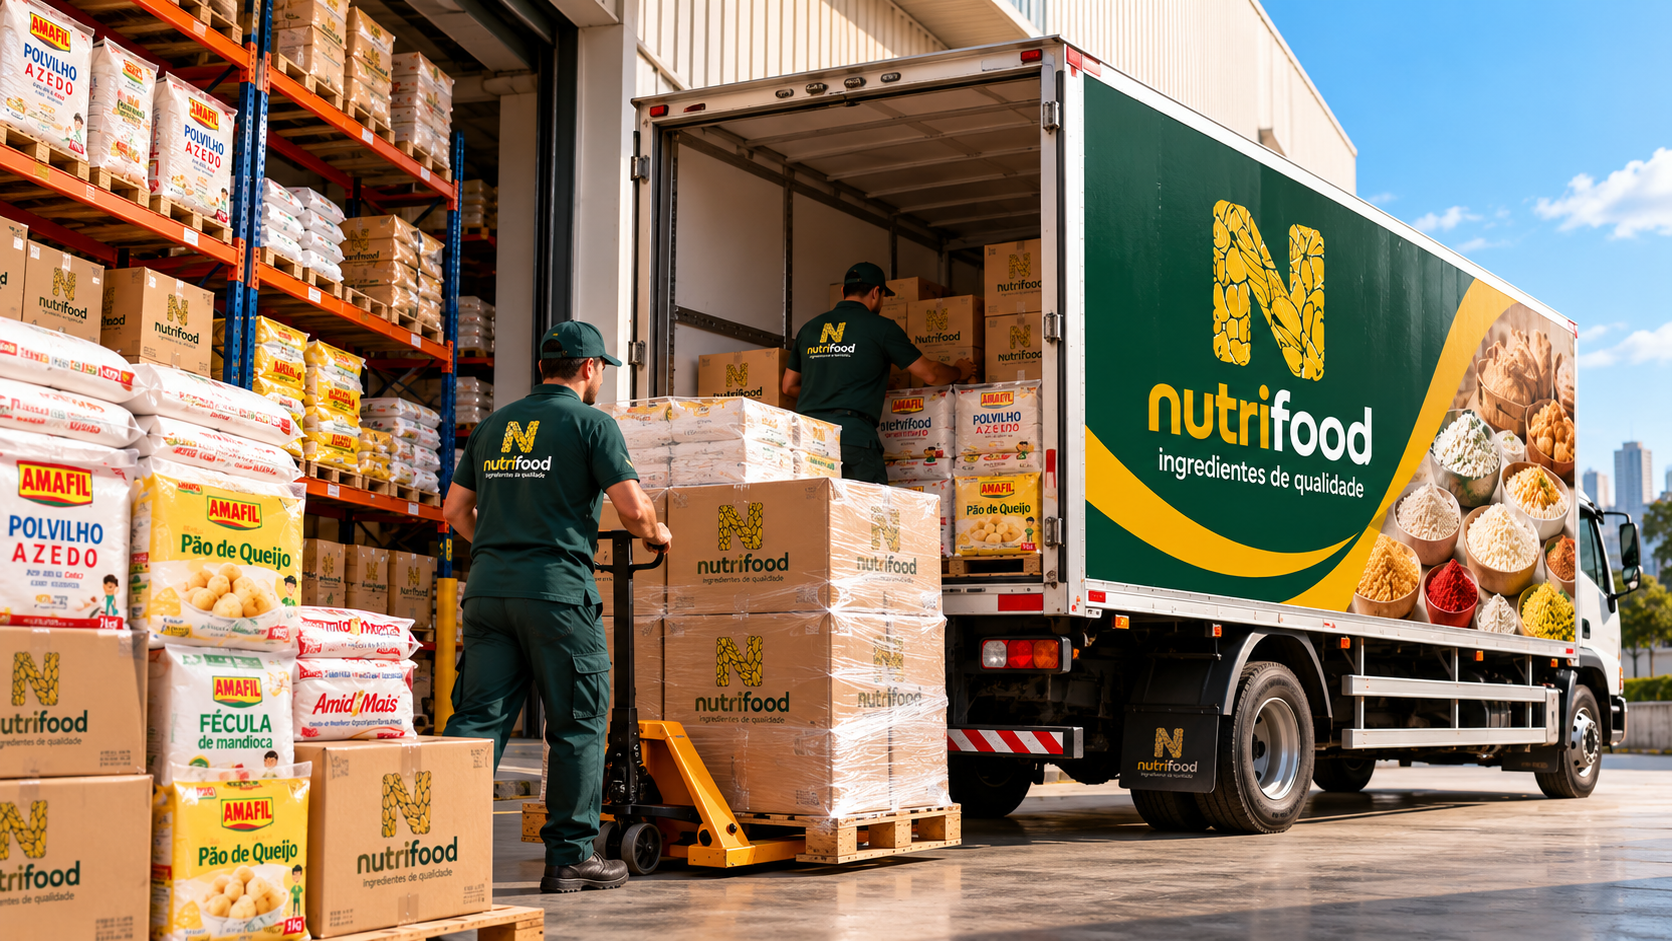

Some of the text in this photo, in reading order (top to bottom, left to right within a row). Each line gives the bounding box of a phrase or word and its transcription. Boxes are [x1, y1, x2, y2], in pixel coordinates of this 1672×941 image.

[32, 15, 69, 47] AMAFIL
[24, 42, 77, 81] POLVILHO
[25, 63, 73, 95] AZEDO
[191, 101, 218, 125] AMAFIL
[184, 124, 224, 155] POLVILHO
[185, 141, 221, 168] AZEDO
[52, 267, 76, 301] N
[1213, 199, 1325, 382] N
[39, 296, 88, 320] nutrifood
[167, 293, 188, 326] N
[155, 322, 199, 345] nutrifood
[820, 322, 846, 343] N
[807, 343, 856, 354] nutrifood
[973, 411, 1021, 425] POLVILHO
[1148, 382, 1373, 466] nutrifood
[501, 421, 540, 453] N
[483, 455, 552, 471] nutrifood
[1158, 447, 1364, 498] ingredientes de qualidade
[22, 467, 91, 497] AMAFIL
[209, 499, 260, 523] AMAFIL
[986, 504, 998, 514] de
[999, 502, 1031, 515] Queijo
[9, 515, 103, 544] POLVILHO
[717, 502, 763, 551] N
[11, 542, 98, 568] AZEDO
[217, 539, 236, 559] de
[240, 543, 291, 571] Queijo
[697, 552, 789, 575] nutrifood
[857, 554, 917, 575] nutrifood
[716, 636, 763, 687] N
[11, 652, 60, 706] N
[215, 679, 261, 697] AMAFIL
[359, 692, 398, 713] Mais
[695, 691, 789, 712] nutrifood
[200, 709, 272, 733] FÉCULA
[36, 738, 45, 746] de
[47, 737, 82, 747] qualidade
[198, 735, 273, 749] de mandioca
[1154, 727, 1184, 758] N
[1137, 760, 1198, 772] nutrifood
[224, 800, 272, 822] AMAFIL
[381, 770, 432, 838] N
[231, 844, 249, 863] de
[252, 839, 298, 865] Queijo
[357, 836, 458, 874] nutrifood
[363, 867, 453, 889] ingredientes de qualidade
[22, 895, 32, 904] de
[34, 891, 75, 905] qualidade
